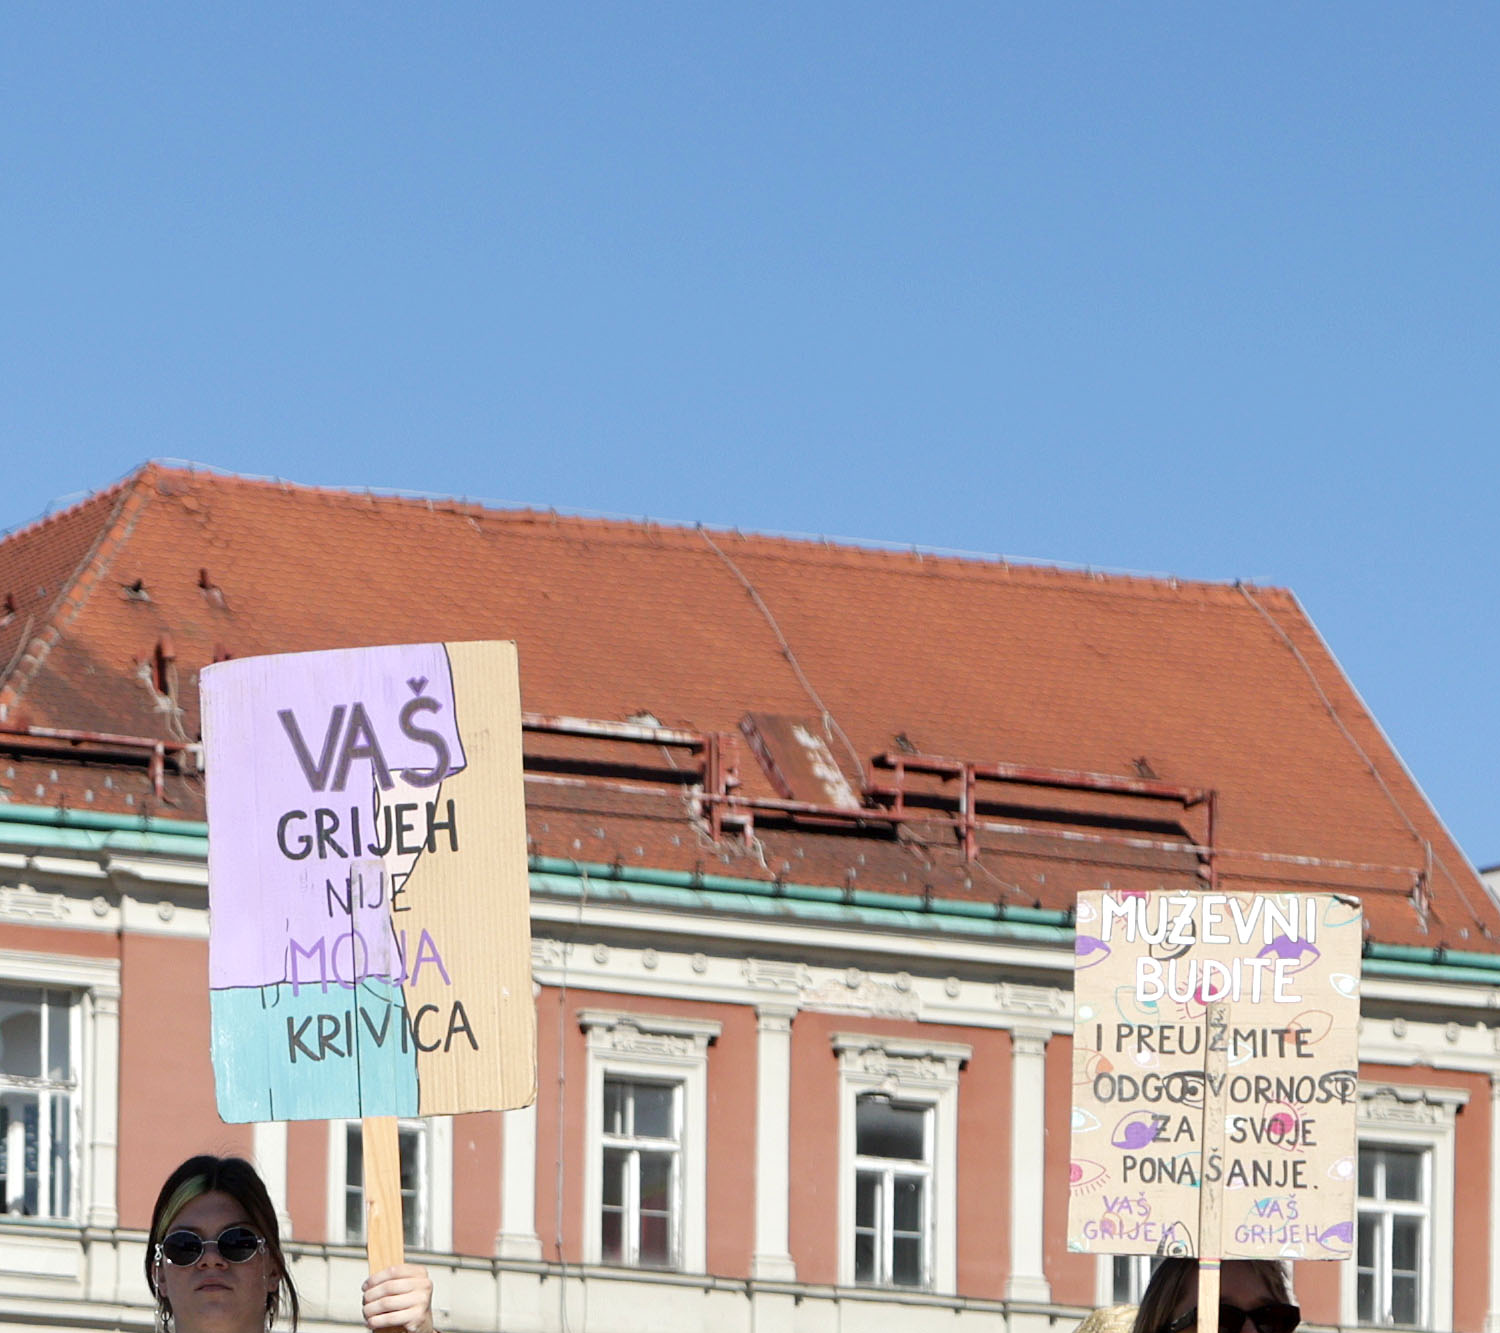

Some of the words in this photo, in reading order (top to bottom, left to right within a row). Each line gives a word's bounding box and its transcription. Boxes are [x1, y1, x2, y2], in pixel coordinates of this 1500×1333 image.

[277, 677, 451, 793] VAŠ
[277, 799, 459, 861] GRIJEH
[325, 872, 412, 918] NIJE
[1101, 889, 1317, 945] MUŽEVNI
[288, 927, 452, 998] MOJA
[1136, 957, 1303, 1004] BUDITE
[286, 1001, 479, 1064] KRIVICA
[1095, 1023, 1103, 1052] I
[1115, 1023, 1315, 1058] PREUZMITE
[1092, 1072, 1357, 1105] ODGOVORNOST
[1150, 1113, 1195, 1143] ZA
[1229, 1116, 1318, 1147] SVOJE
[1122, 1147, 1319, 1191] PONAŠANJE.
[1102, 1190, 1150, 1217] VAŠ
[1254, 1193, 1300, 1221] VAŠ
[1083, 1220, 1178, 1243] GRIJEH
[1235, 1223, 1319, 1244] GRIJEH
